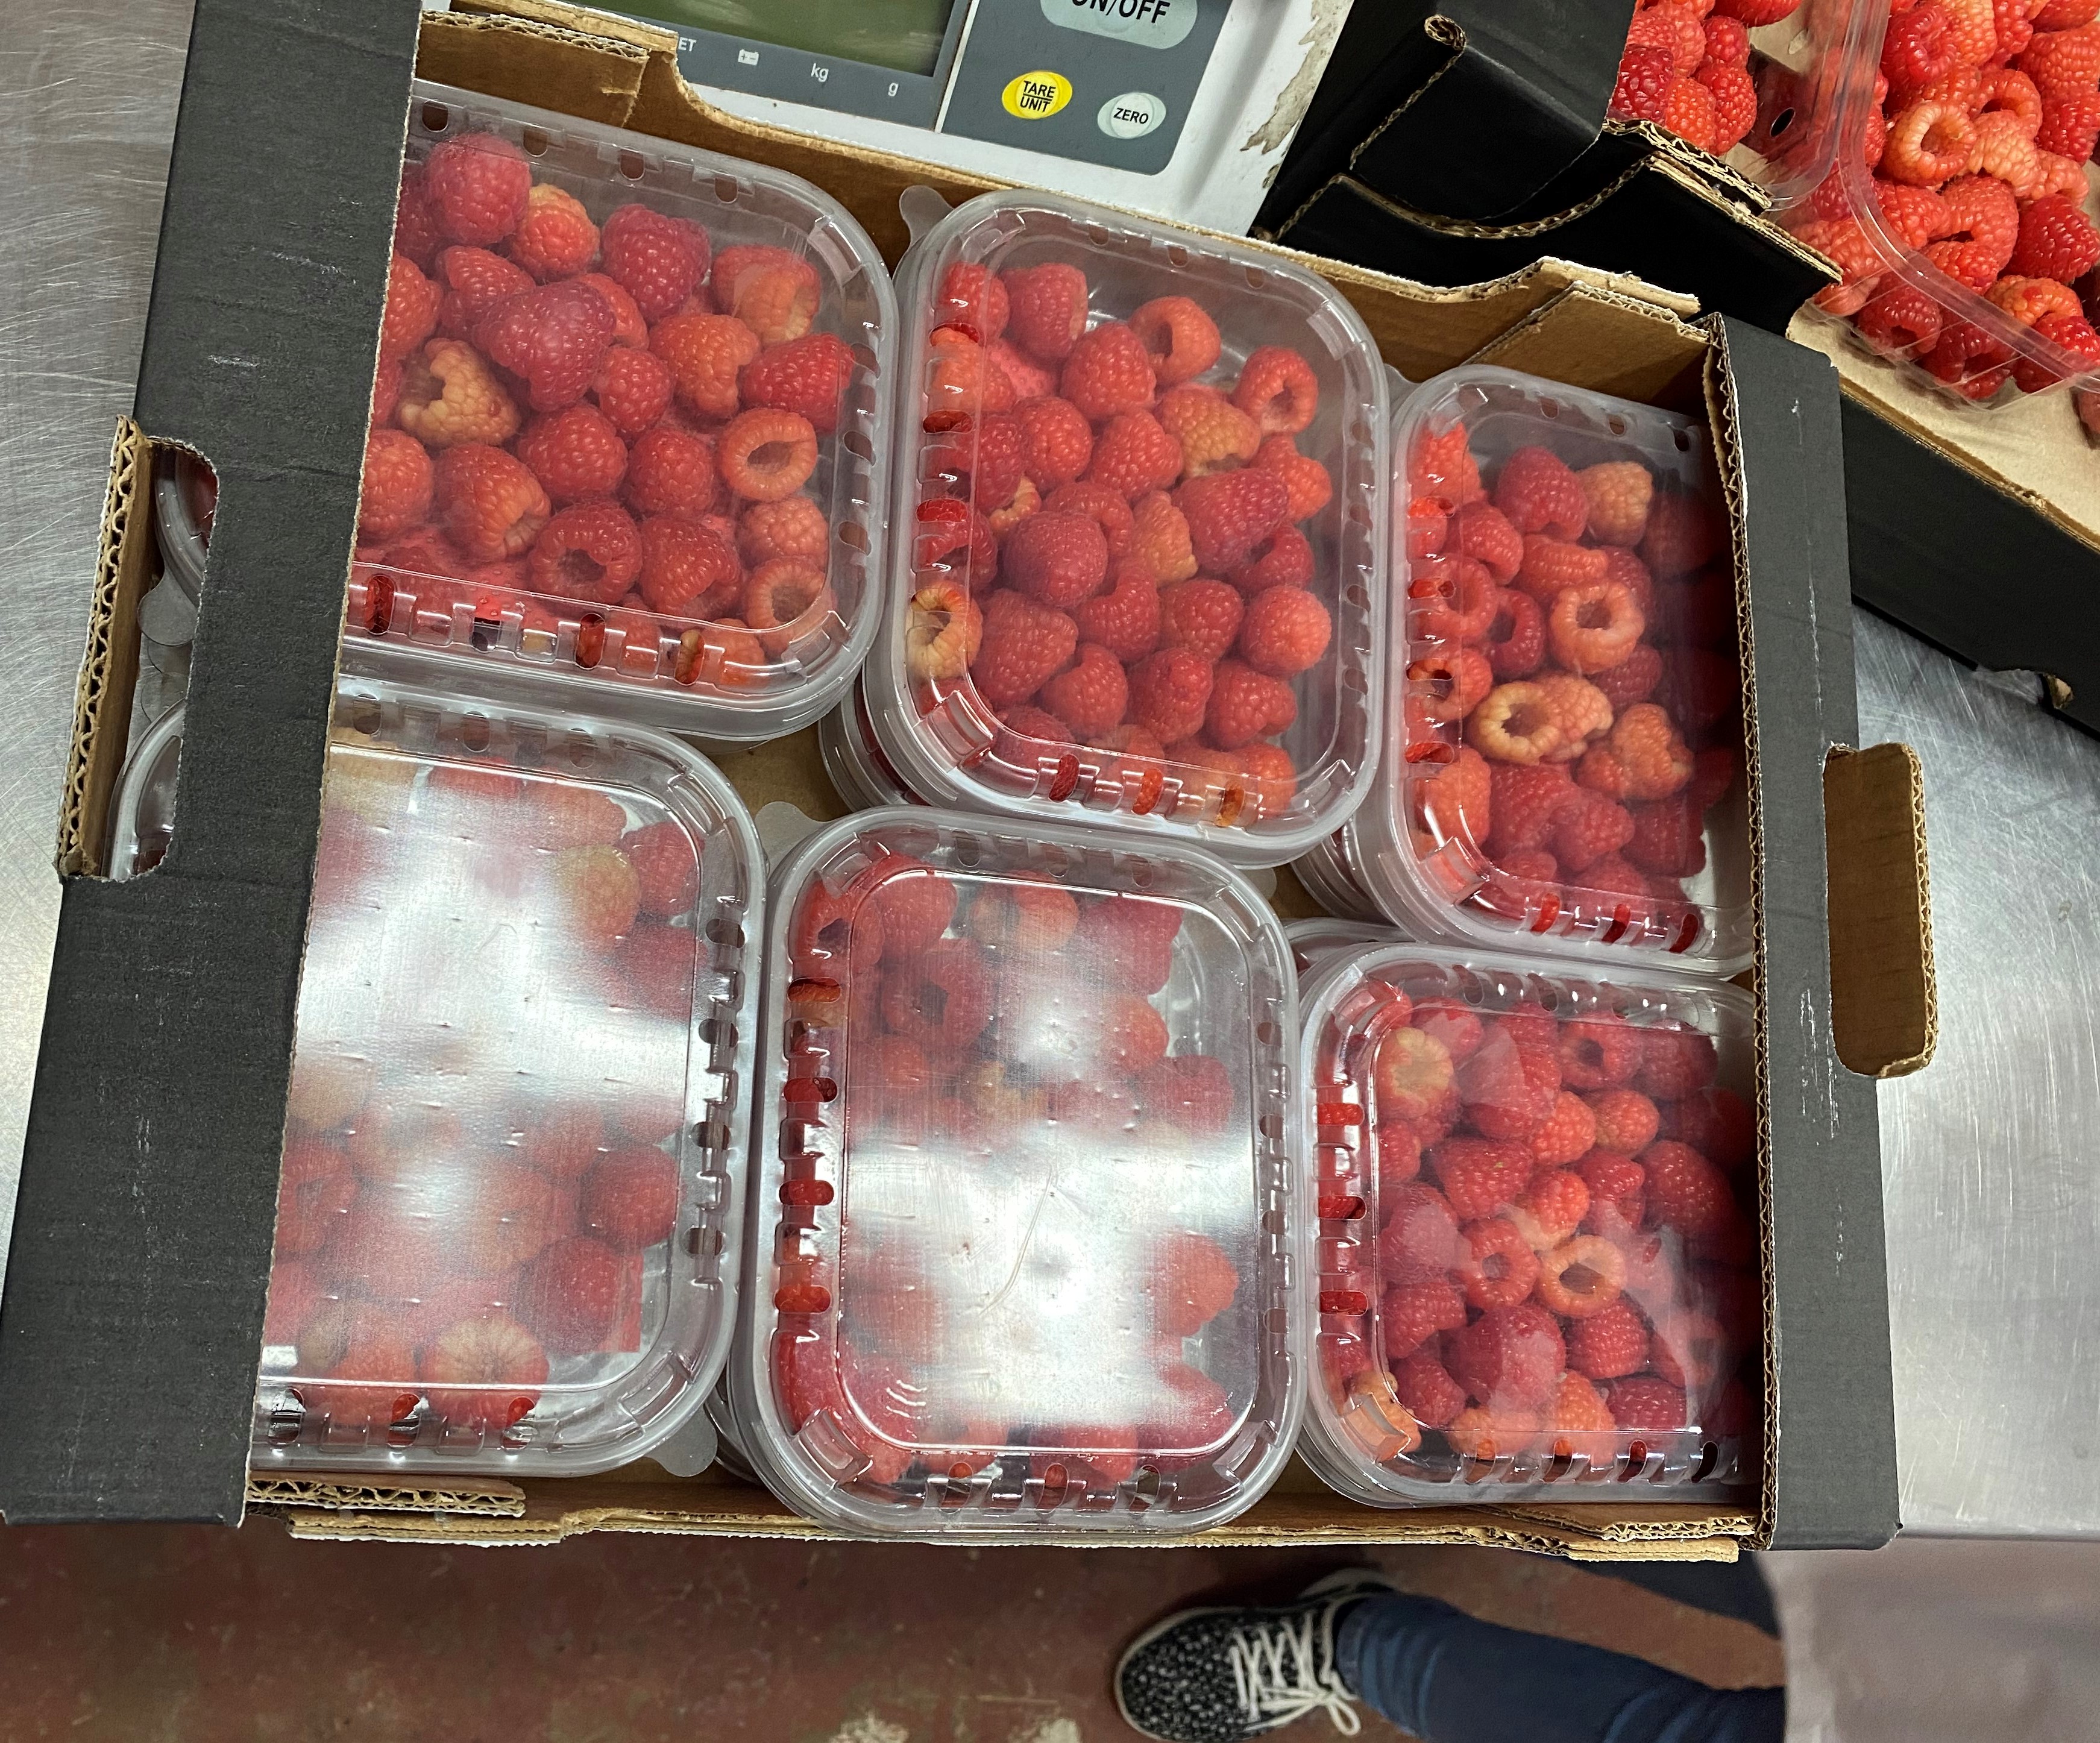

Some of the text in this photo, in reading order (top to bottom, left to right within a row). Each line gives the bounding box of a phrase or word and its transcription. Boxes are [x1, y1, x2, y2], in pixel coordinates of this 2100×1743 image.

[1072, 0, 1171, 24] /OFF
[678, 37, 697, 52] ET
[811, 63, 829, 83] kg
[888, 82, 899, 96] g
[1023, 80, 1056, 98] TARE
[1020, 96, 1051, 112] UNIT
[1113, 107, 1149, 124] ZERO
